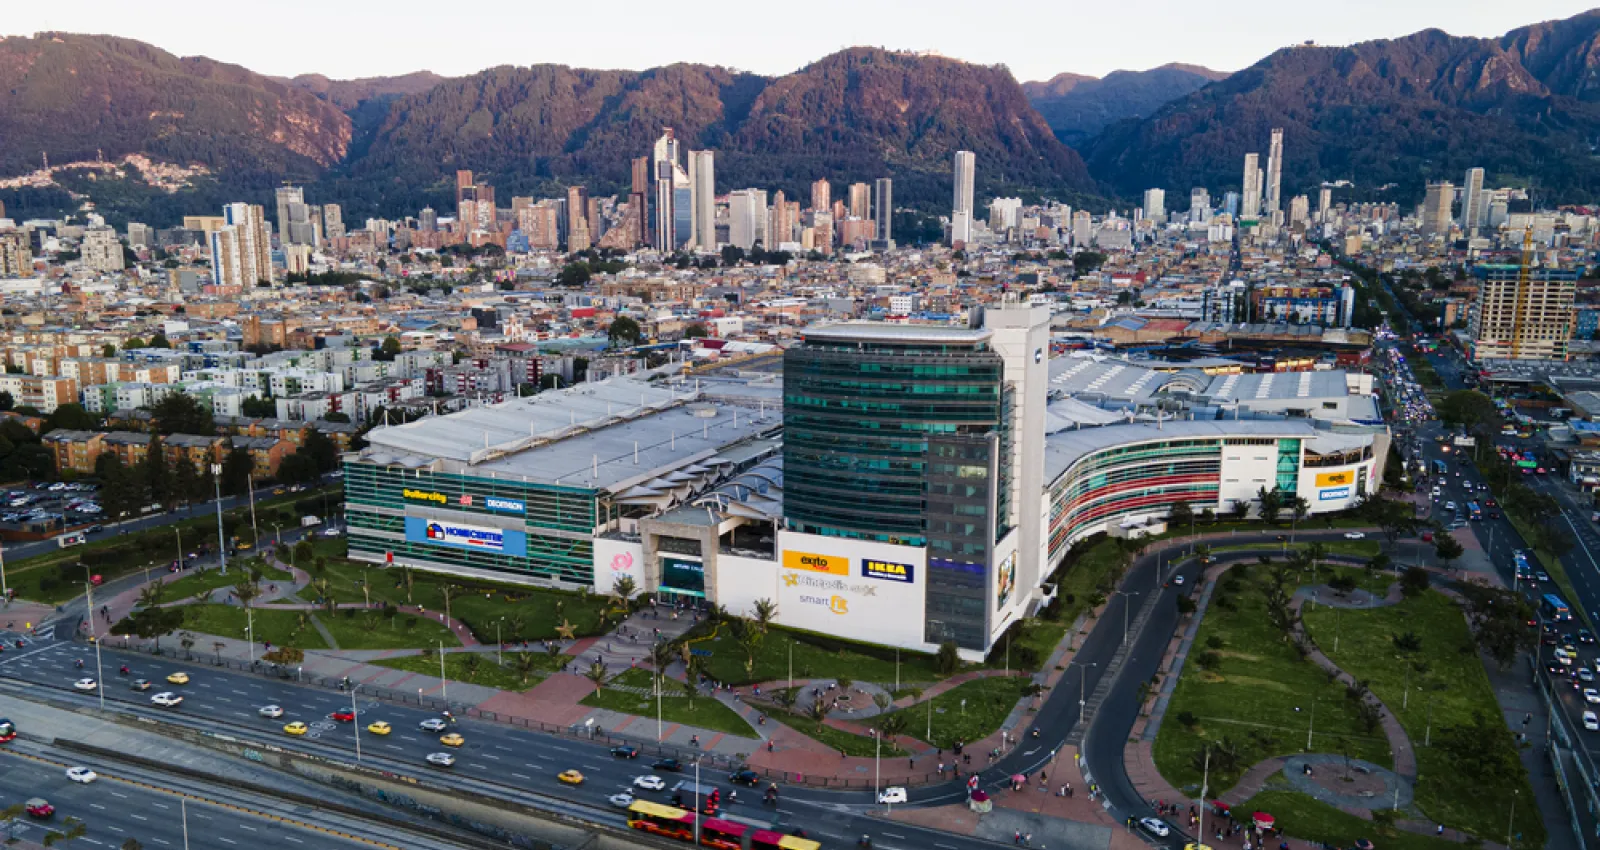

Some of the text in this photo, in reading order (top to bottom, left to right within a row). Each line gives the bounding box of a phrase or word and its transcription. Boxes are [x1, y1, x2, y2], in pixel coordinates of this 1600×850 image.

[445, 526, 503, 542] HOMECENTER
[868, 561, 906, 575] IKEA
[799, 595, 830, 606] smart
